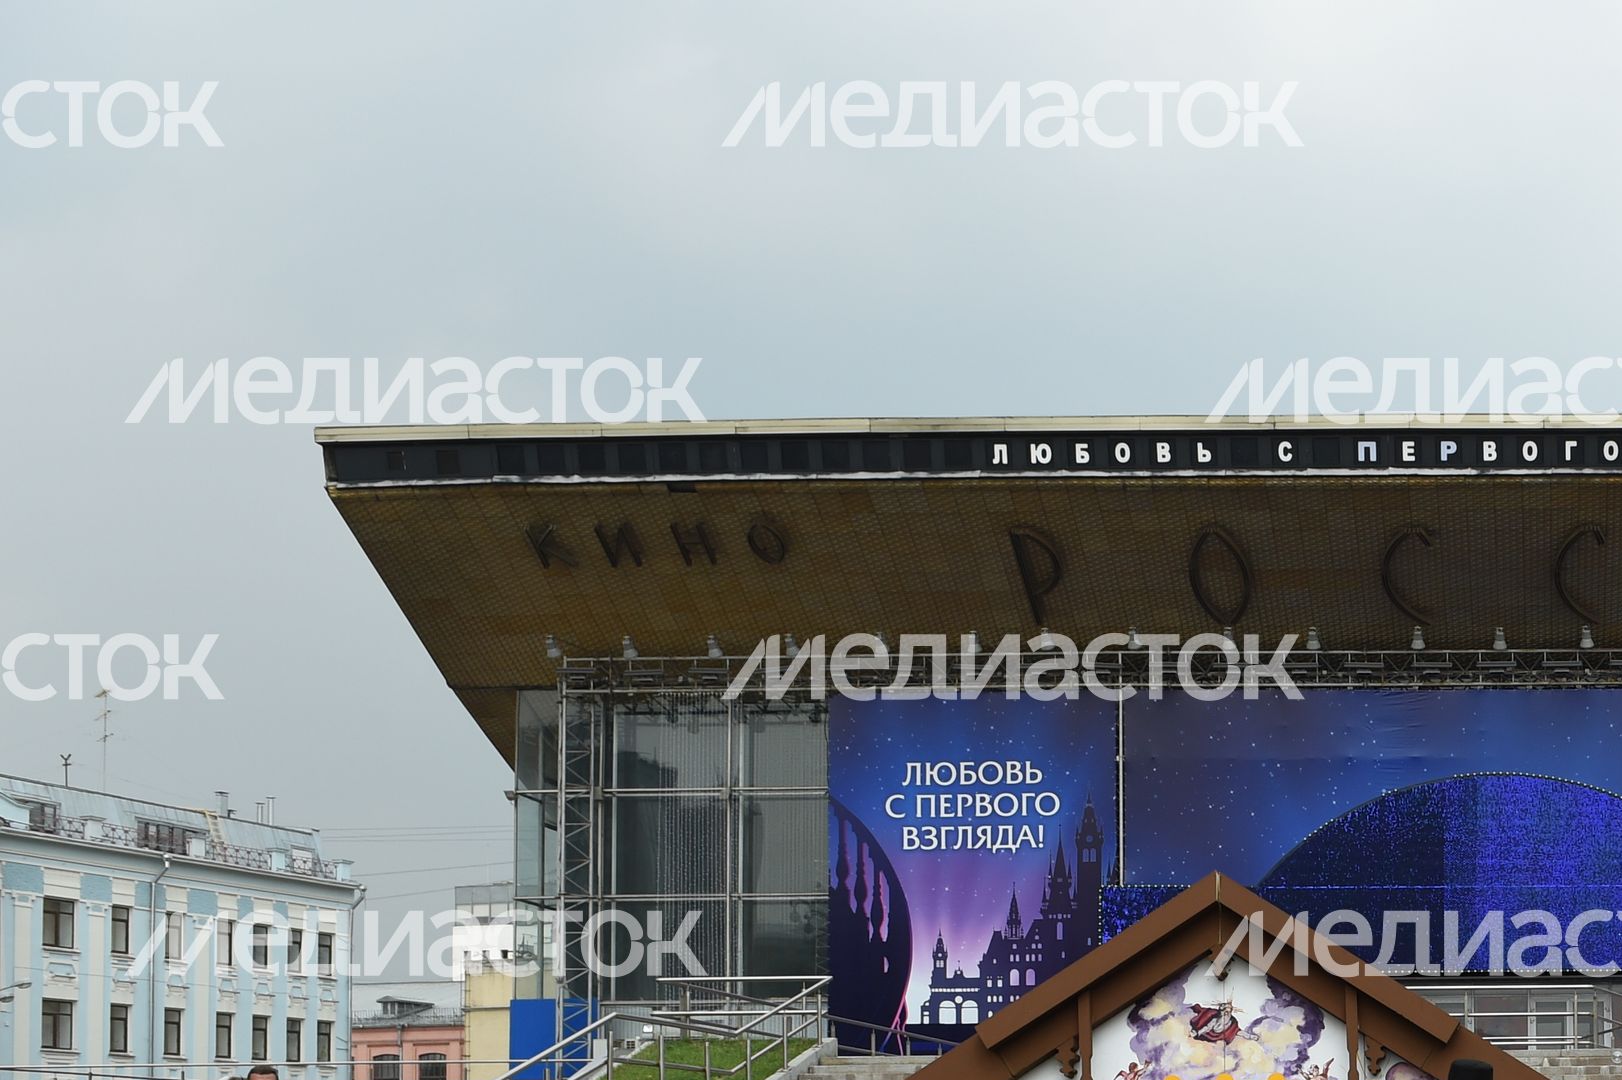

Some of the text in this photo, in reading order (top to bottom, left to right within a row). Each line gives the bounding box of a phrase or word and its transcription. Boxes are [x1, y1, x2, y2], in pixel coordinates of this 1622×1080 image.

[992, 442, 1212, 465] ЛЮБОВЬ
[1278, 441, 1293, 462] С
[1357, 440, 1619, 463] ПЕРВОГО
[524, 521, 789, 569] КИНО
[902, 760, 1043, 786] ЛЮБОВЬ
[885, 792, 1060, 819] С ПЕРВОГО
[902, 824, 1044, 854] ВЗГЛЯДА!
